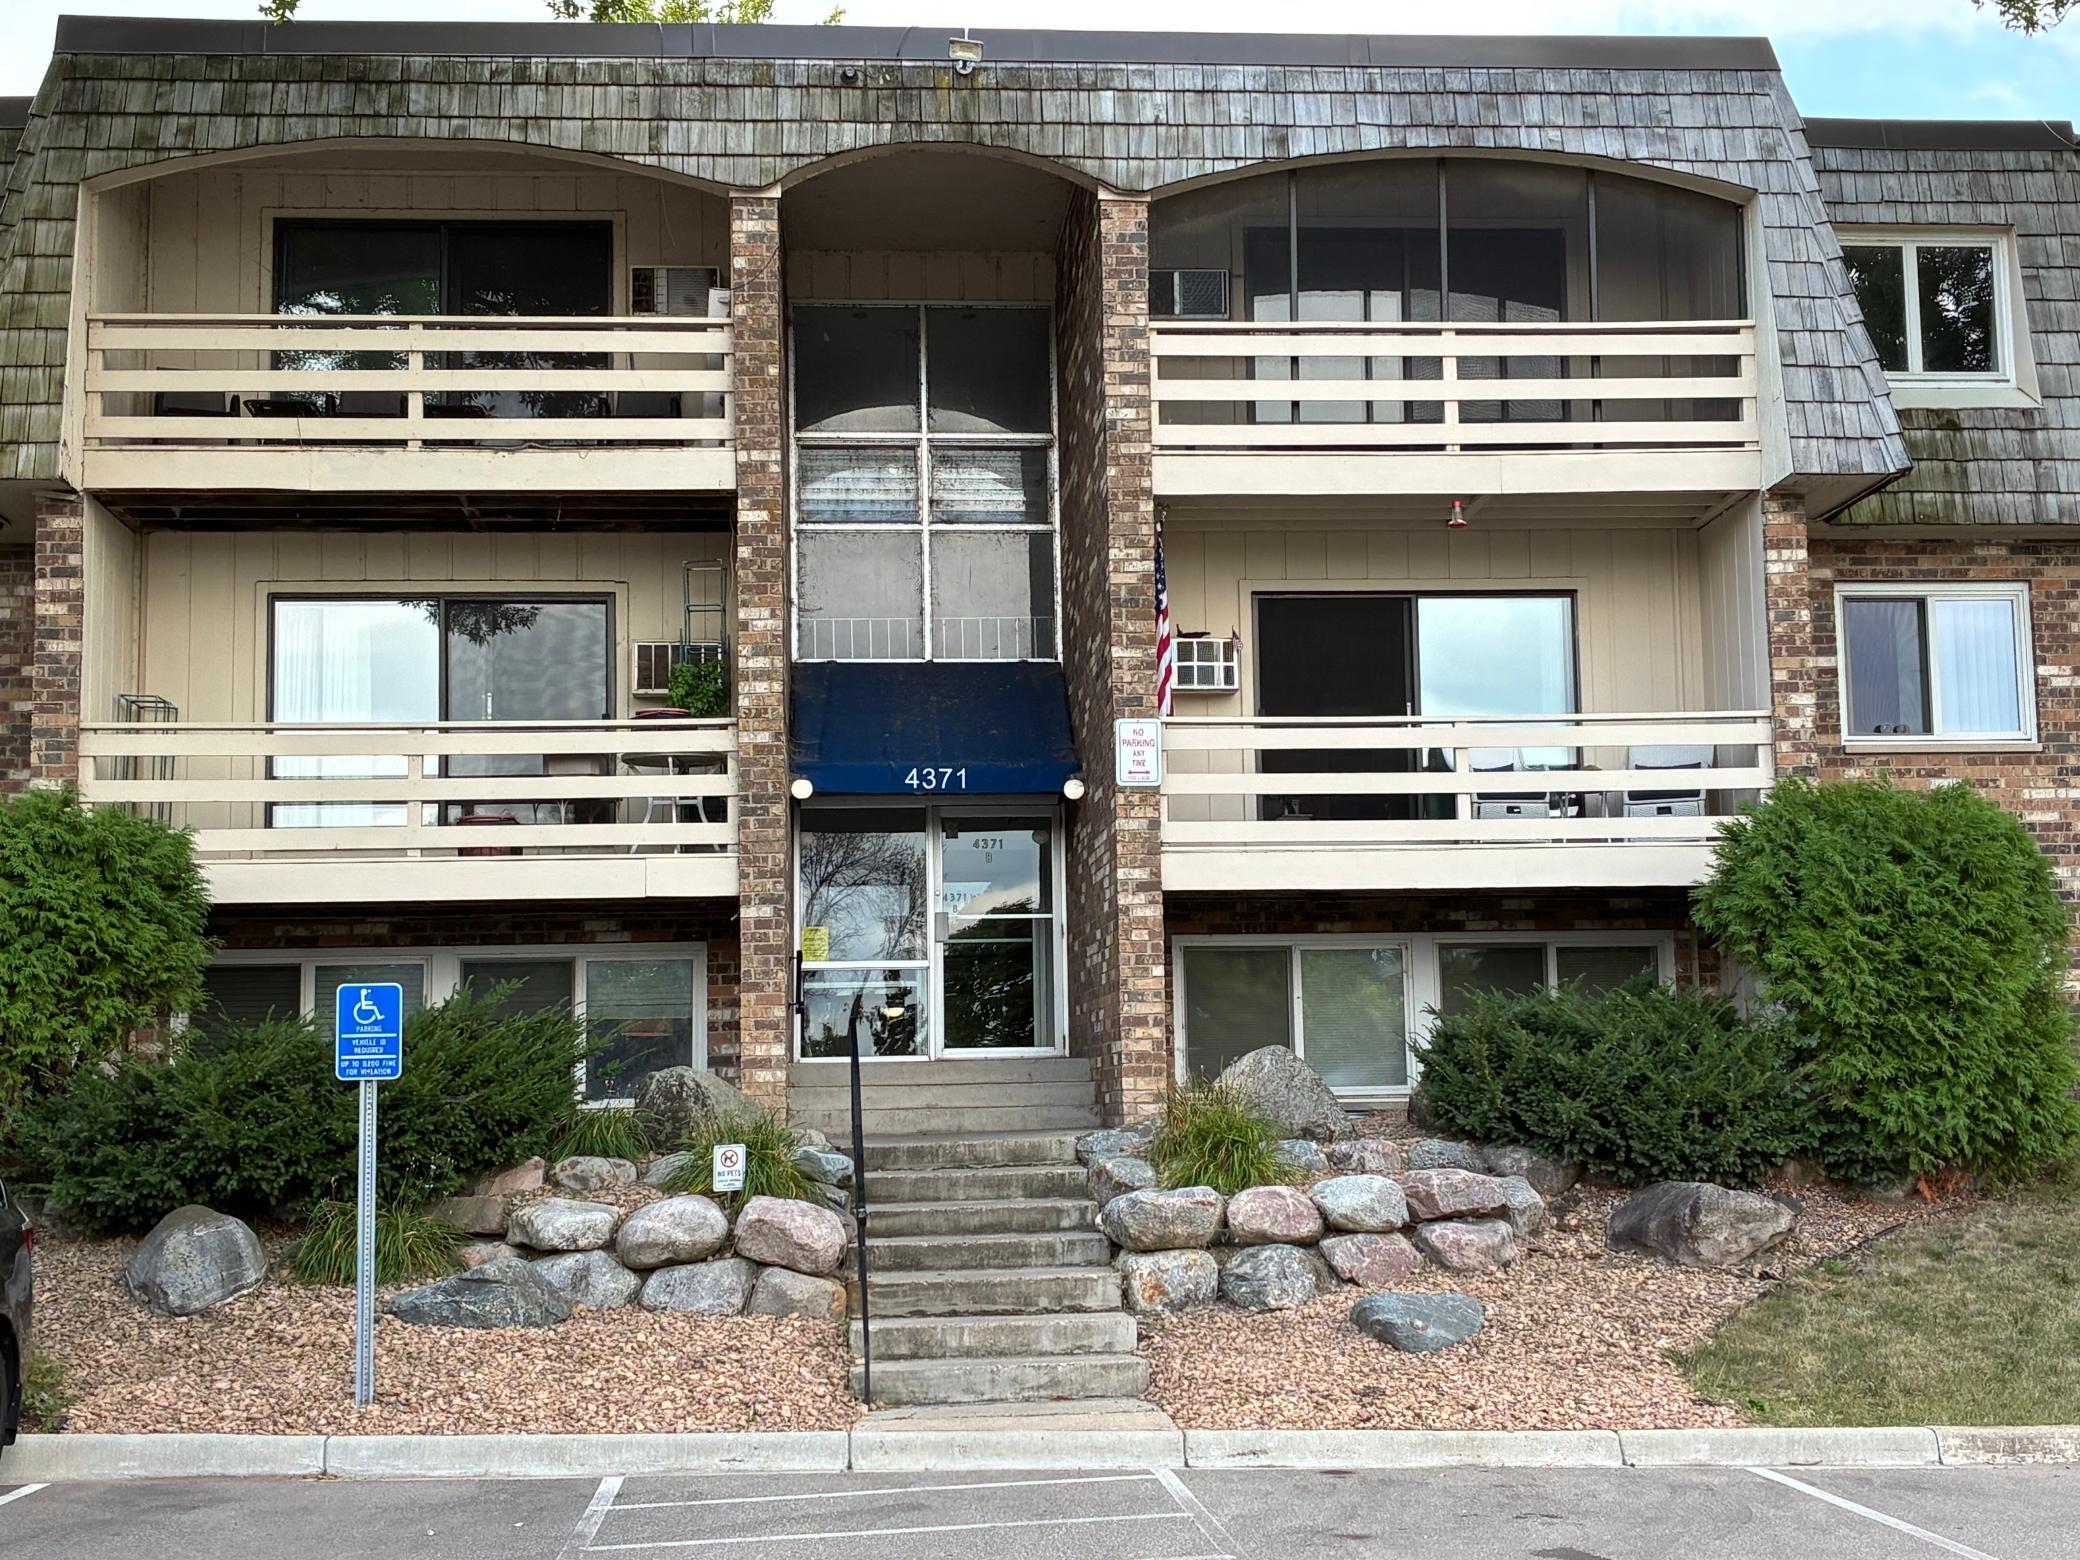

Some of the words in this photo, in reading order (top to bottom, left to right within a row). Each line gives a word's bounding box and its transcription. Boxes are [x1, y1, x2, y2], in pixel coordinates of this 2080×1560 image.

[1132, 728, 1144, 736] NO
[1122, 738, 1156, 748] PARKING
[1132, 759, 1146, 767] TIME
[904, 767, 966, 790] 4371
[972, 838, 1004, 850] 4371
[352, 1038, 376, 1046] VEHICLE
[382, 1059, 396, 1067] FINE
[727, 1169, 741, 1177] PETS
